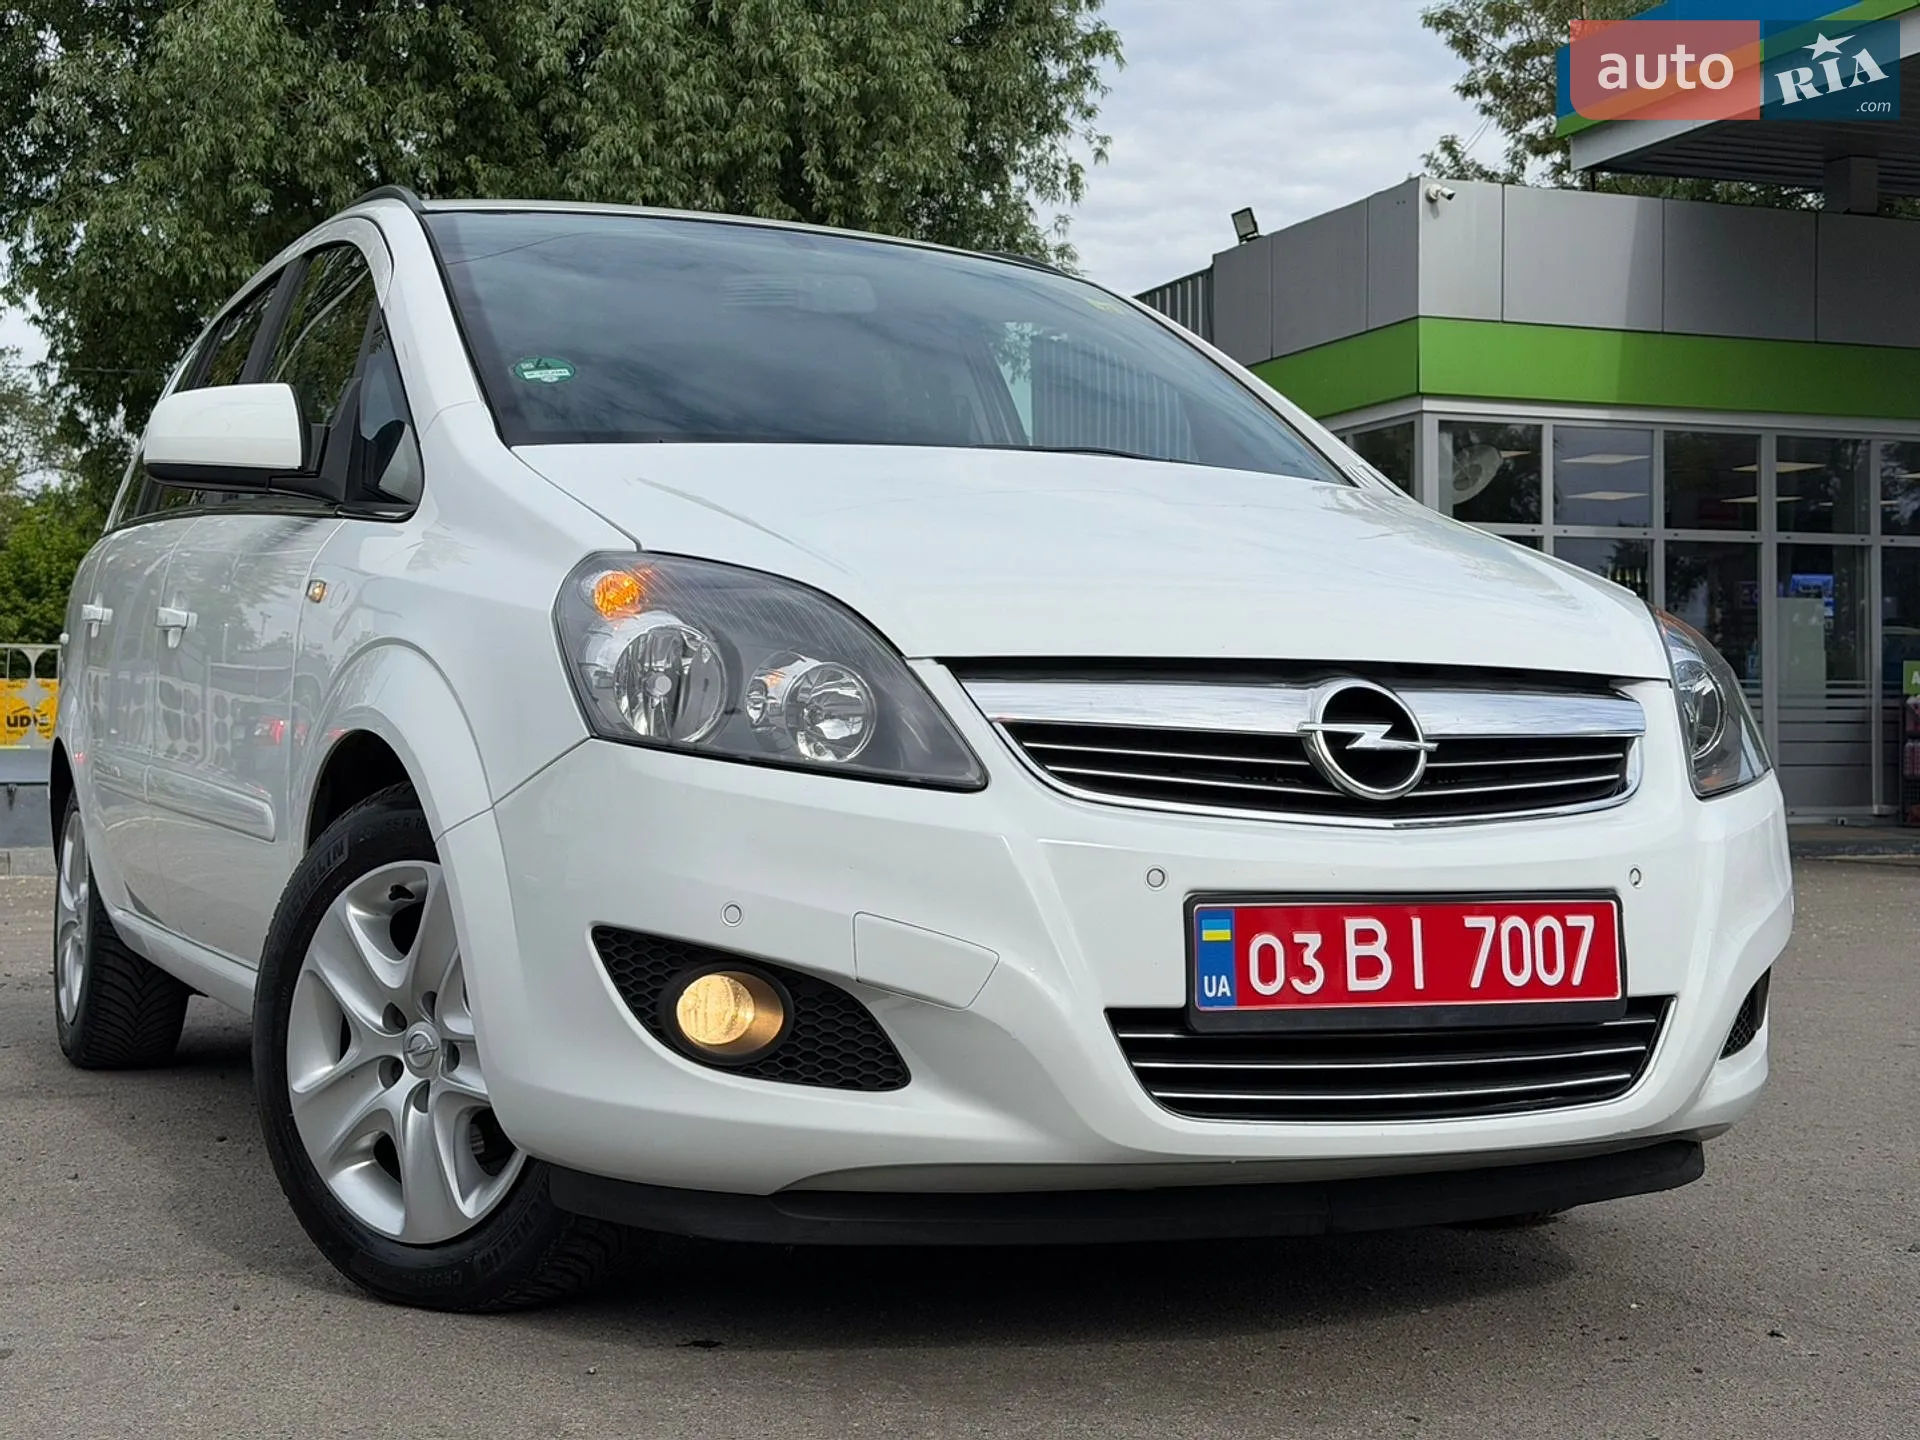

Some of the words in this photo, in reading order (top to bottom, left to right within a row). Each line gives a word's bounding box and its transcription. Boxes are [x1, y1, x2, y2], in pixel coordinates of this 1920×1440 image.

[1249, 933, 1324, 996] 03
[1464, 915, 1594, 989] 7007
[1203, 975, 1231, 998] UA
